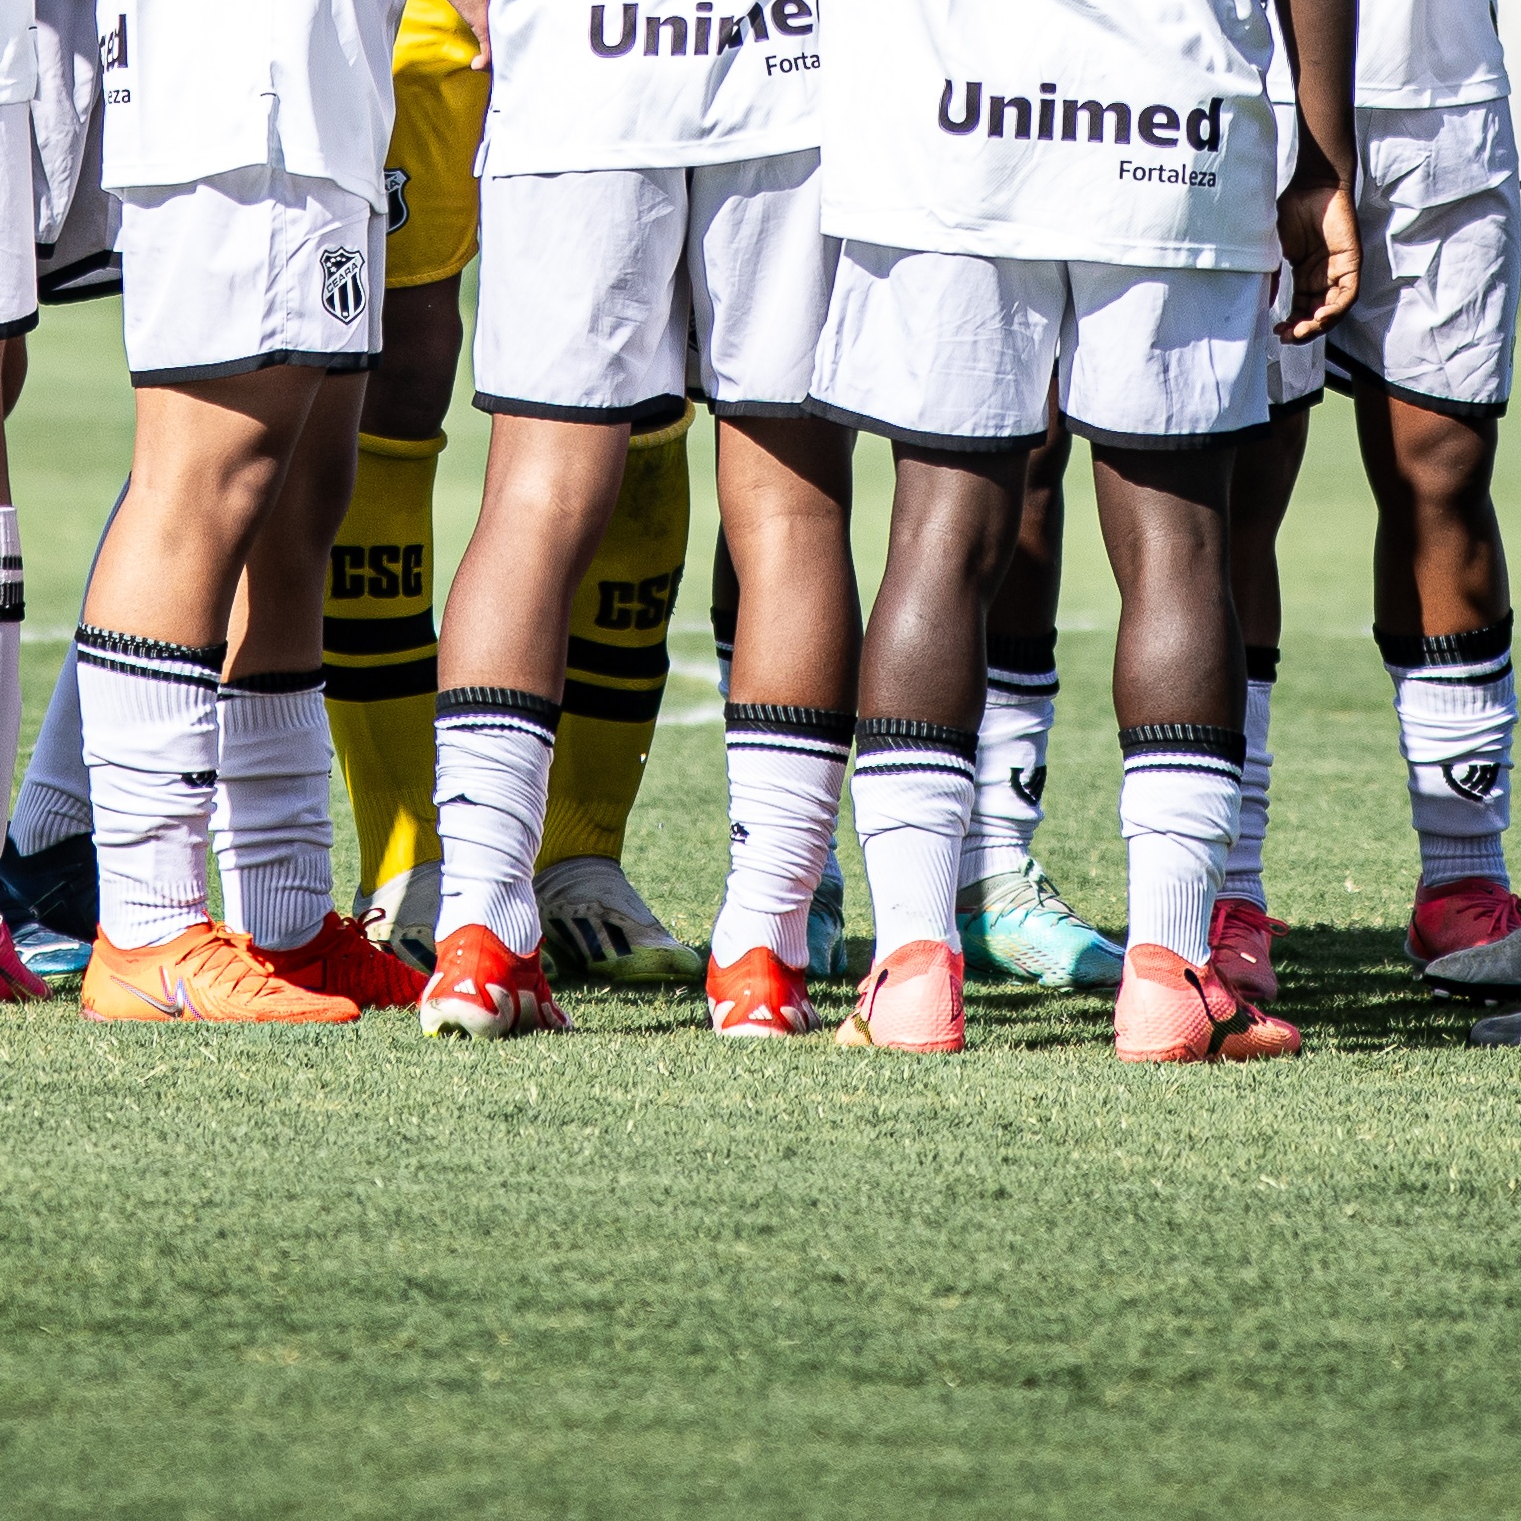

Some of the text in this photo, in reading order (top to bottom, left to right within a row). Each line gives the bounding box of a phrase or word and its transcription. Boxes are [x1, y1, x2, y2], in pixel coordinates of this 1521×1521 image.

[765, 52, 820, 76] Forta
[938, 79, 1224, 152] Unimed
[1119, 160, 1216, 187] Fortaleza
[330, 544, 424, 599] CSC
